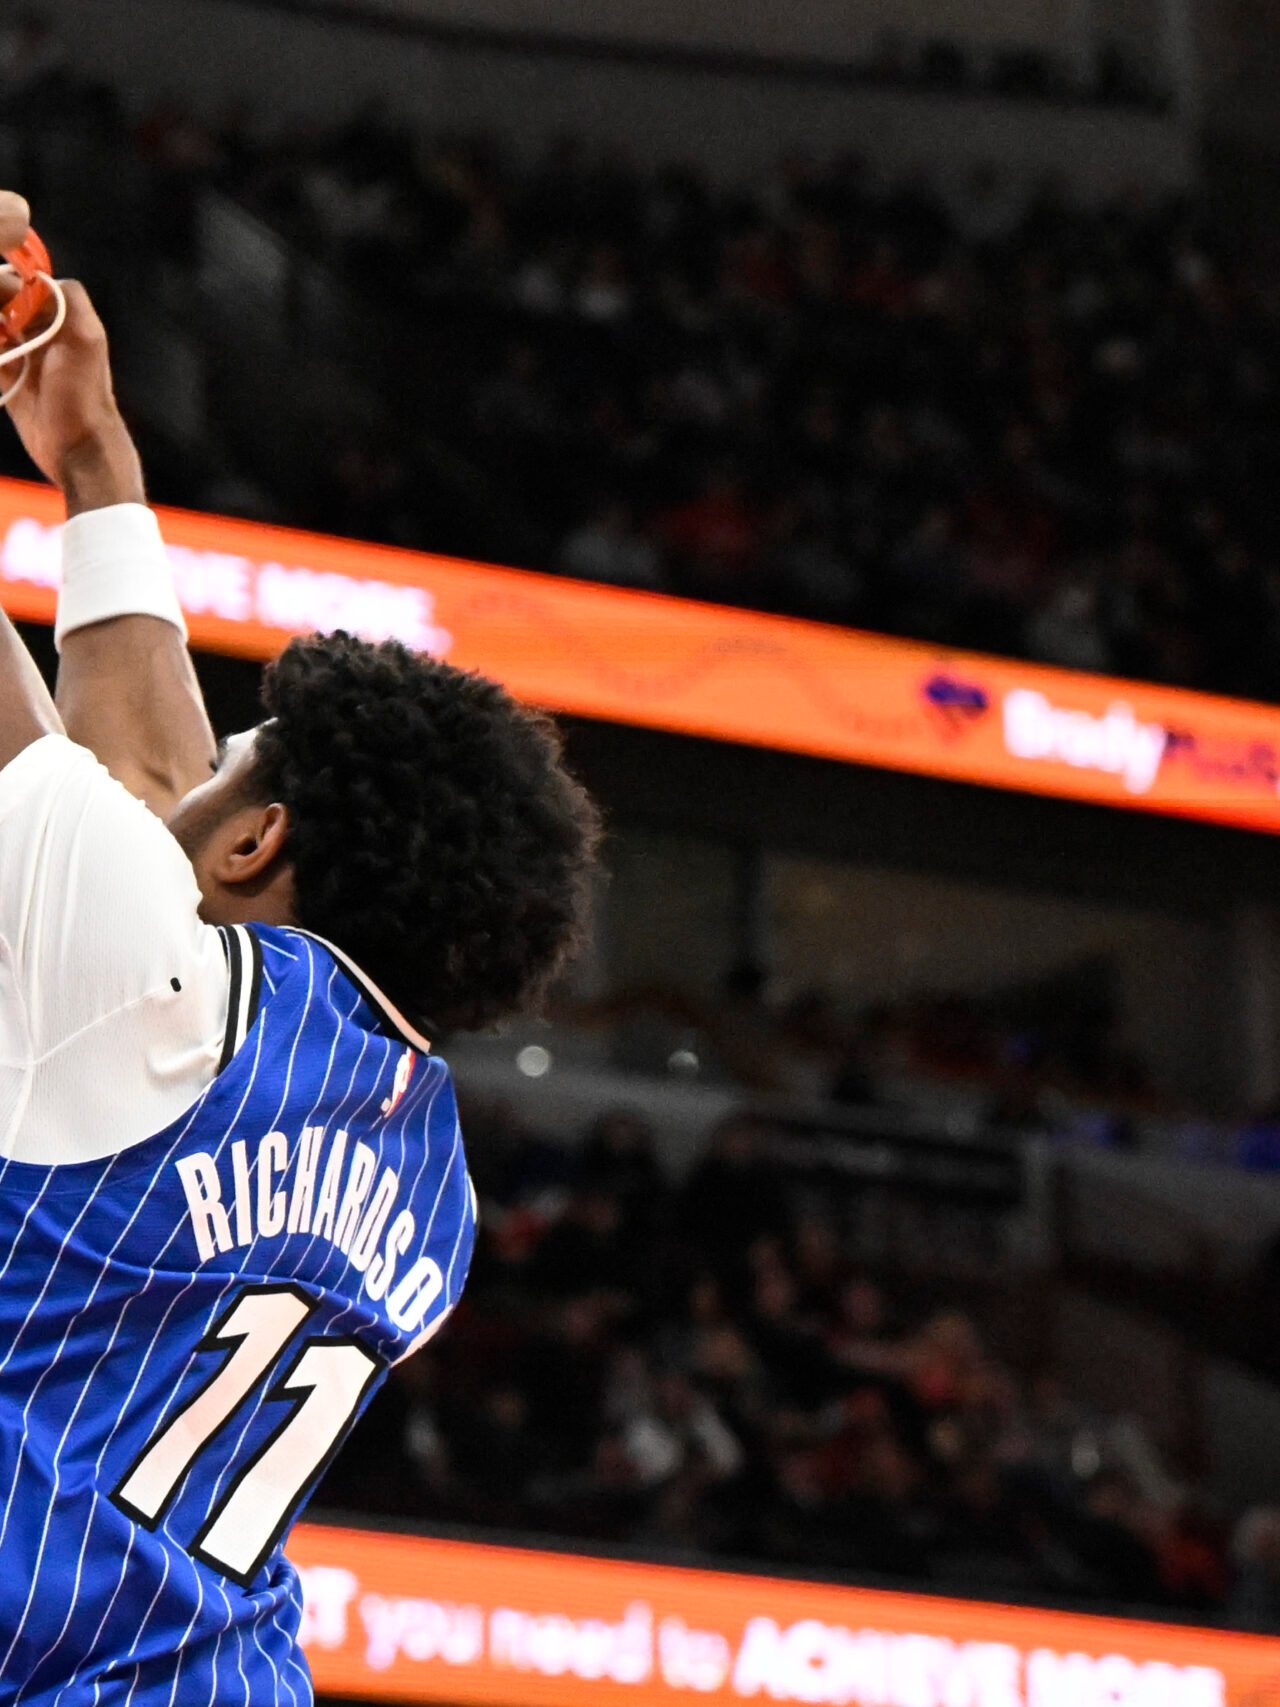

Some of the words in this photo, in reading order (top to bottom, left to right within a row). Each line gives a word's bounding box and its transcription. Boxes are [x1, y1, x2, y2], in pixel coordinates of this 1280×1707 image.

[109, 1282, 392, 1588] 11
[358, 1592, 485, 1670] you
[489, 1600, 654, 1685] need
[658, 1615, 729, 1692] to
